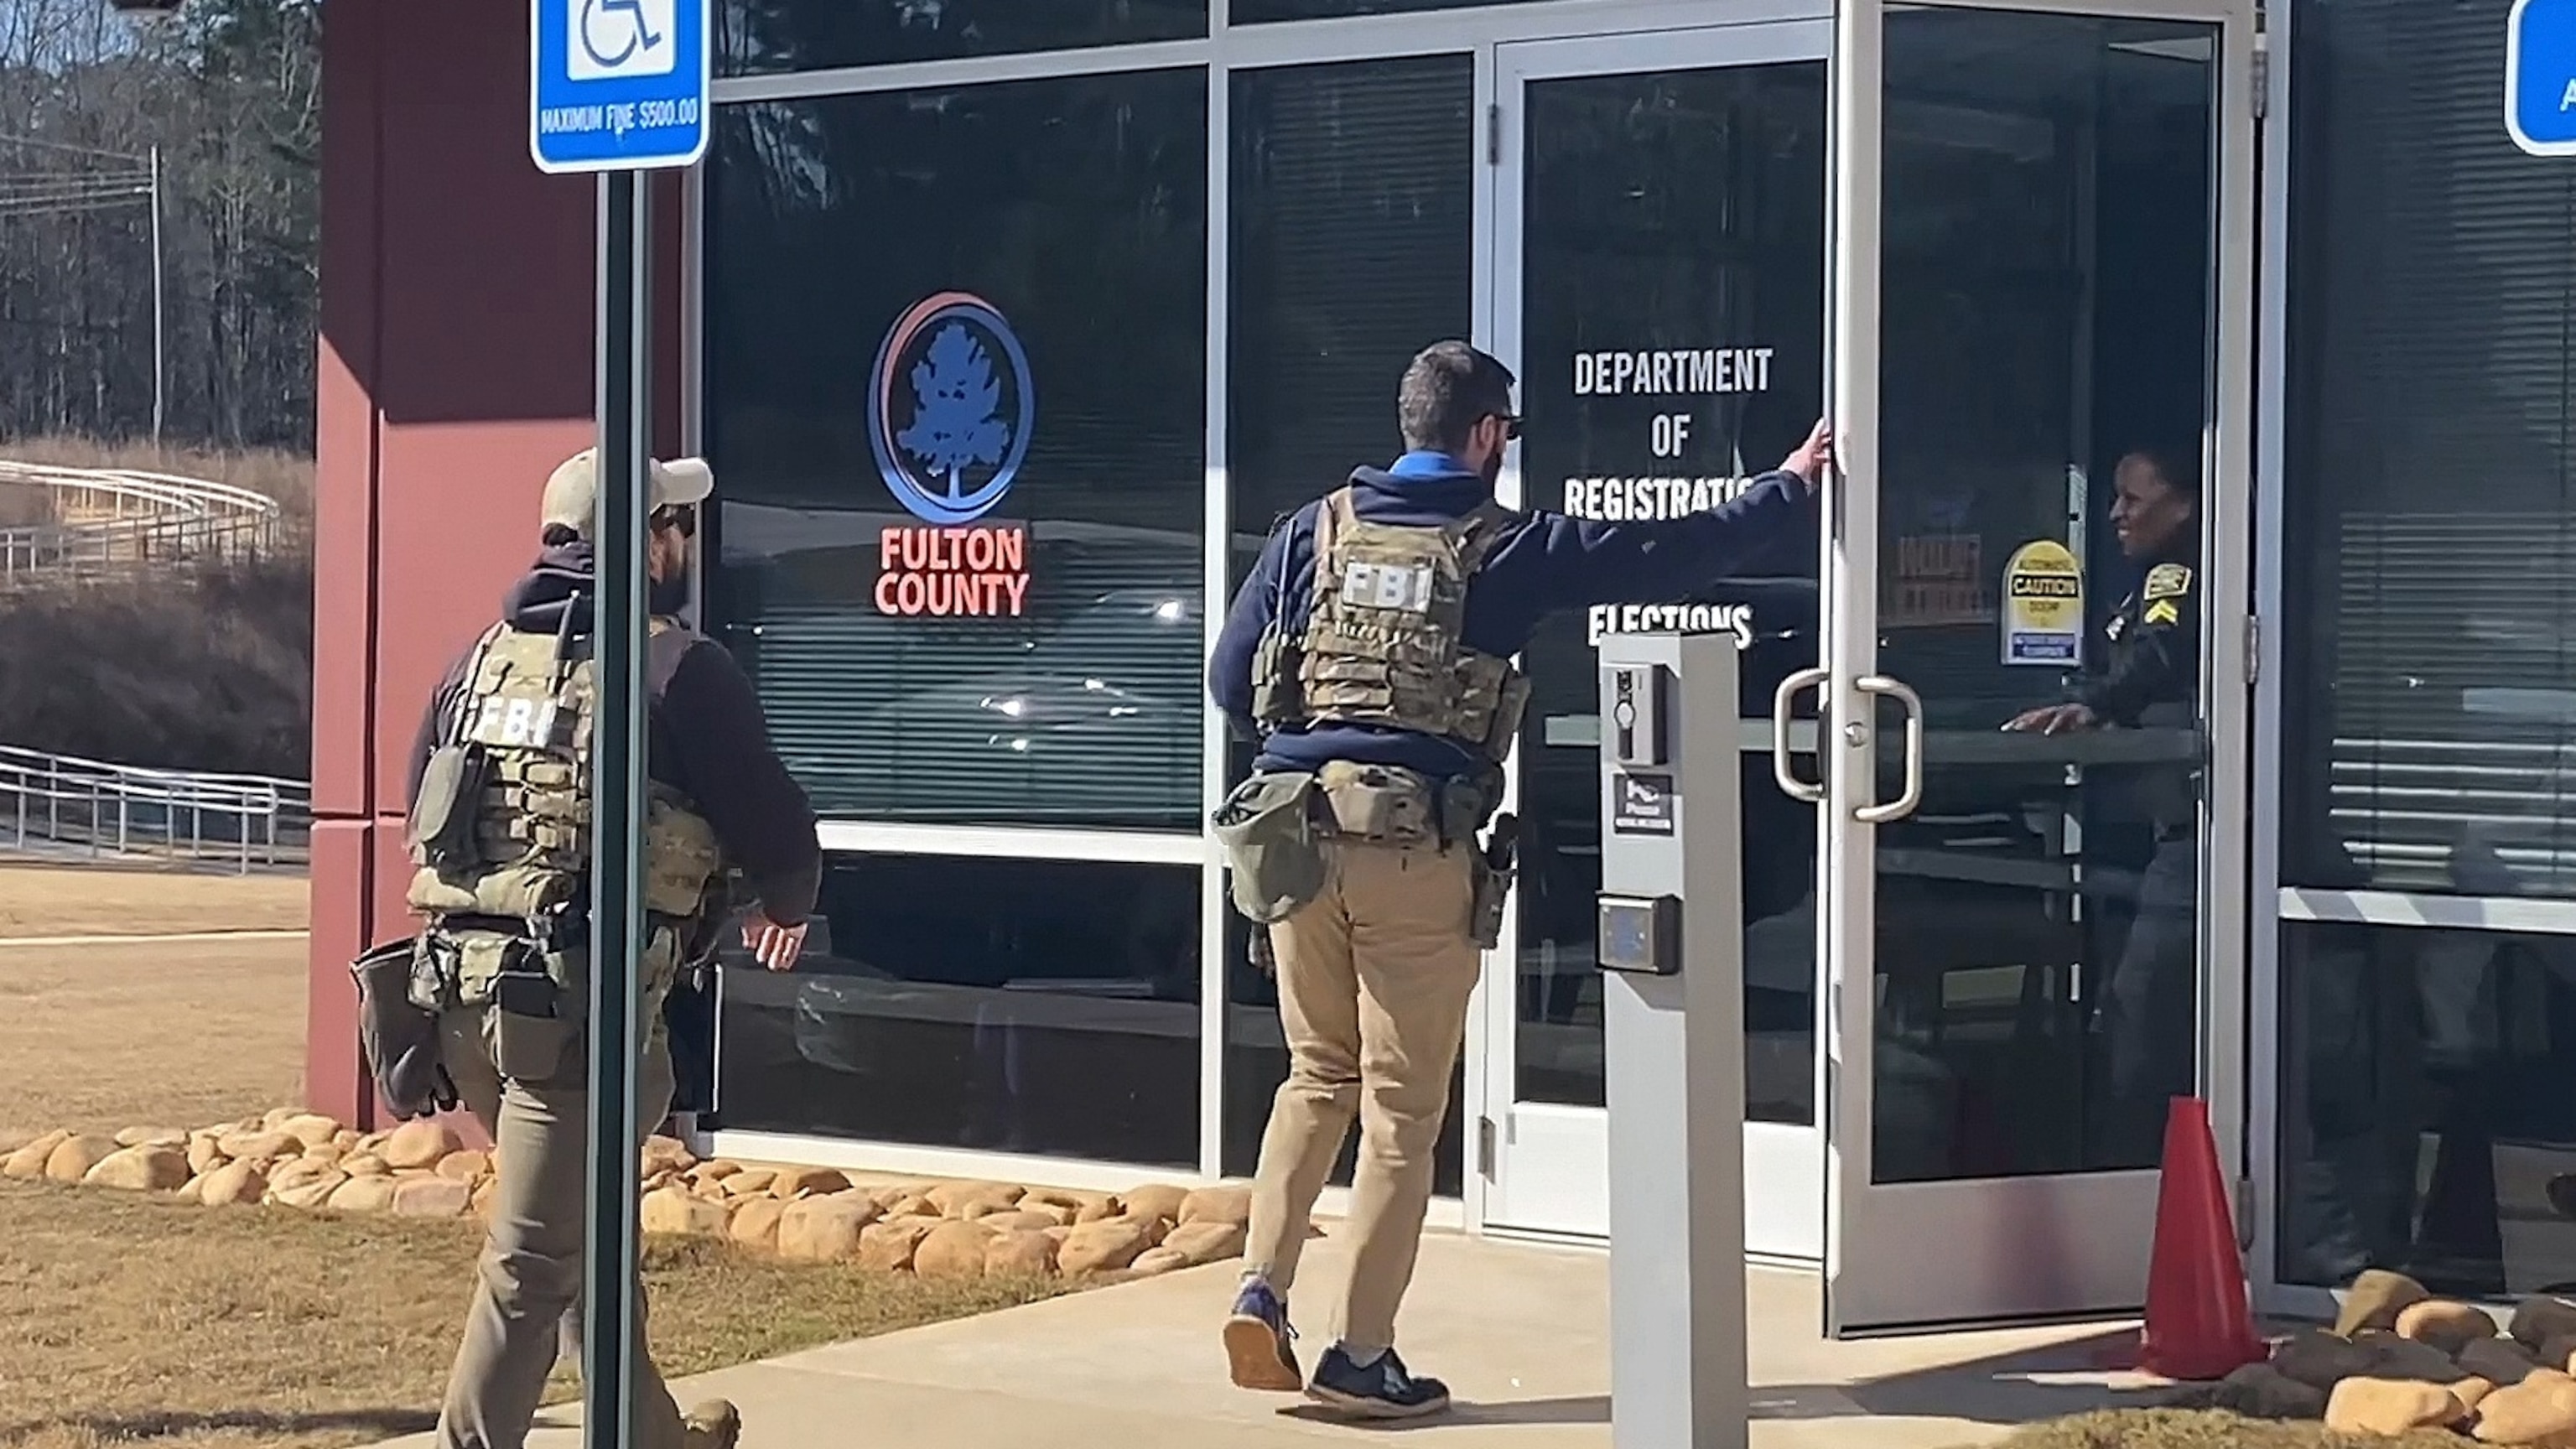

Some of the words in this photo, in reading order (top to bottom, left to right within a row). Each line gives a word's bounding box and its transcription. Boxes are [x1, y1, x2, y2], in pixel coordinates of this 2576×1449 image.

[542, 105, 602, 133] MAXIMUM
[606, 102, 635, 130] FINE
[640, 97, 698, 127] $500.00
[1574, 348, 1773, 395] DEPARTMENT
[1650, 413, 1691, 457] OF
[1564, 477, 1754, 521] REGISTRATI
[880, 527, 1023, 571] FULTON
[874, 573, 1030, 617] COUNTY
[1343, 563, 1433, 613] FBI
[2013, 577, 2075, 595] CAUTION
[470, 695, 557, 749] FBI
